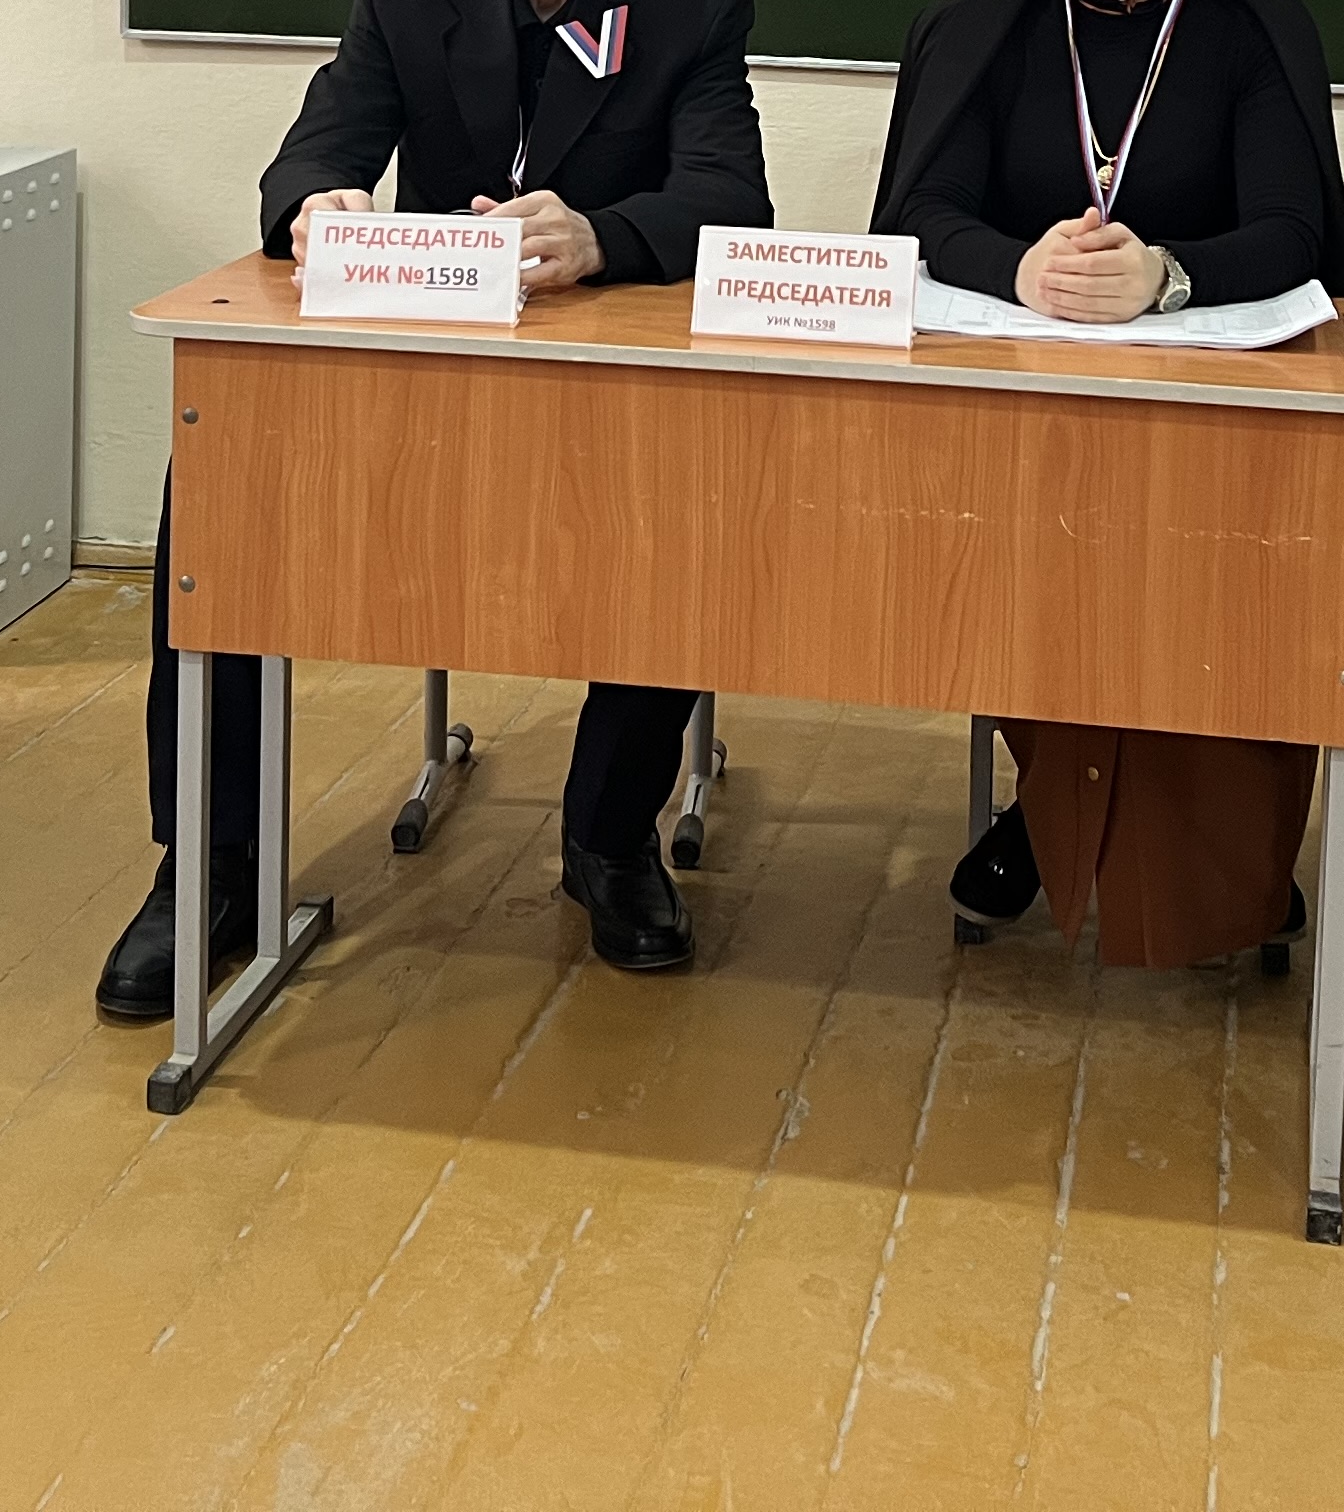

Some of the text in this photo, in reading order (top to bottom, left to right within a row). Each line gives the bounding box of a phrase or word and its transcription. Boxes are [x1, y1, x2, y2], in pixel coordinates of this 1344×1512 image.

[325, 226, 504, 251] ПРЕДСЕДАТЕЛЬ
[727, 242, 888, 269] ЗАМЕСТИТЕЛЬ
[344, 264, 478, 291] УИК №1598
[718, 278, 891, 308] ПРЕДСЕДАТЕЛЯ
[767, 316, 835, 331] УИК №1598
